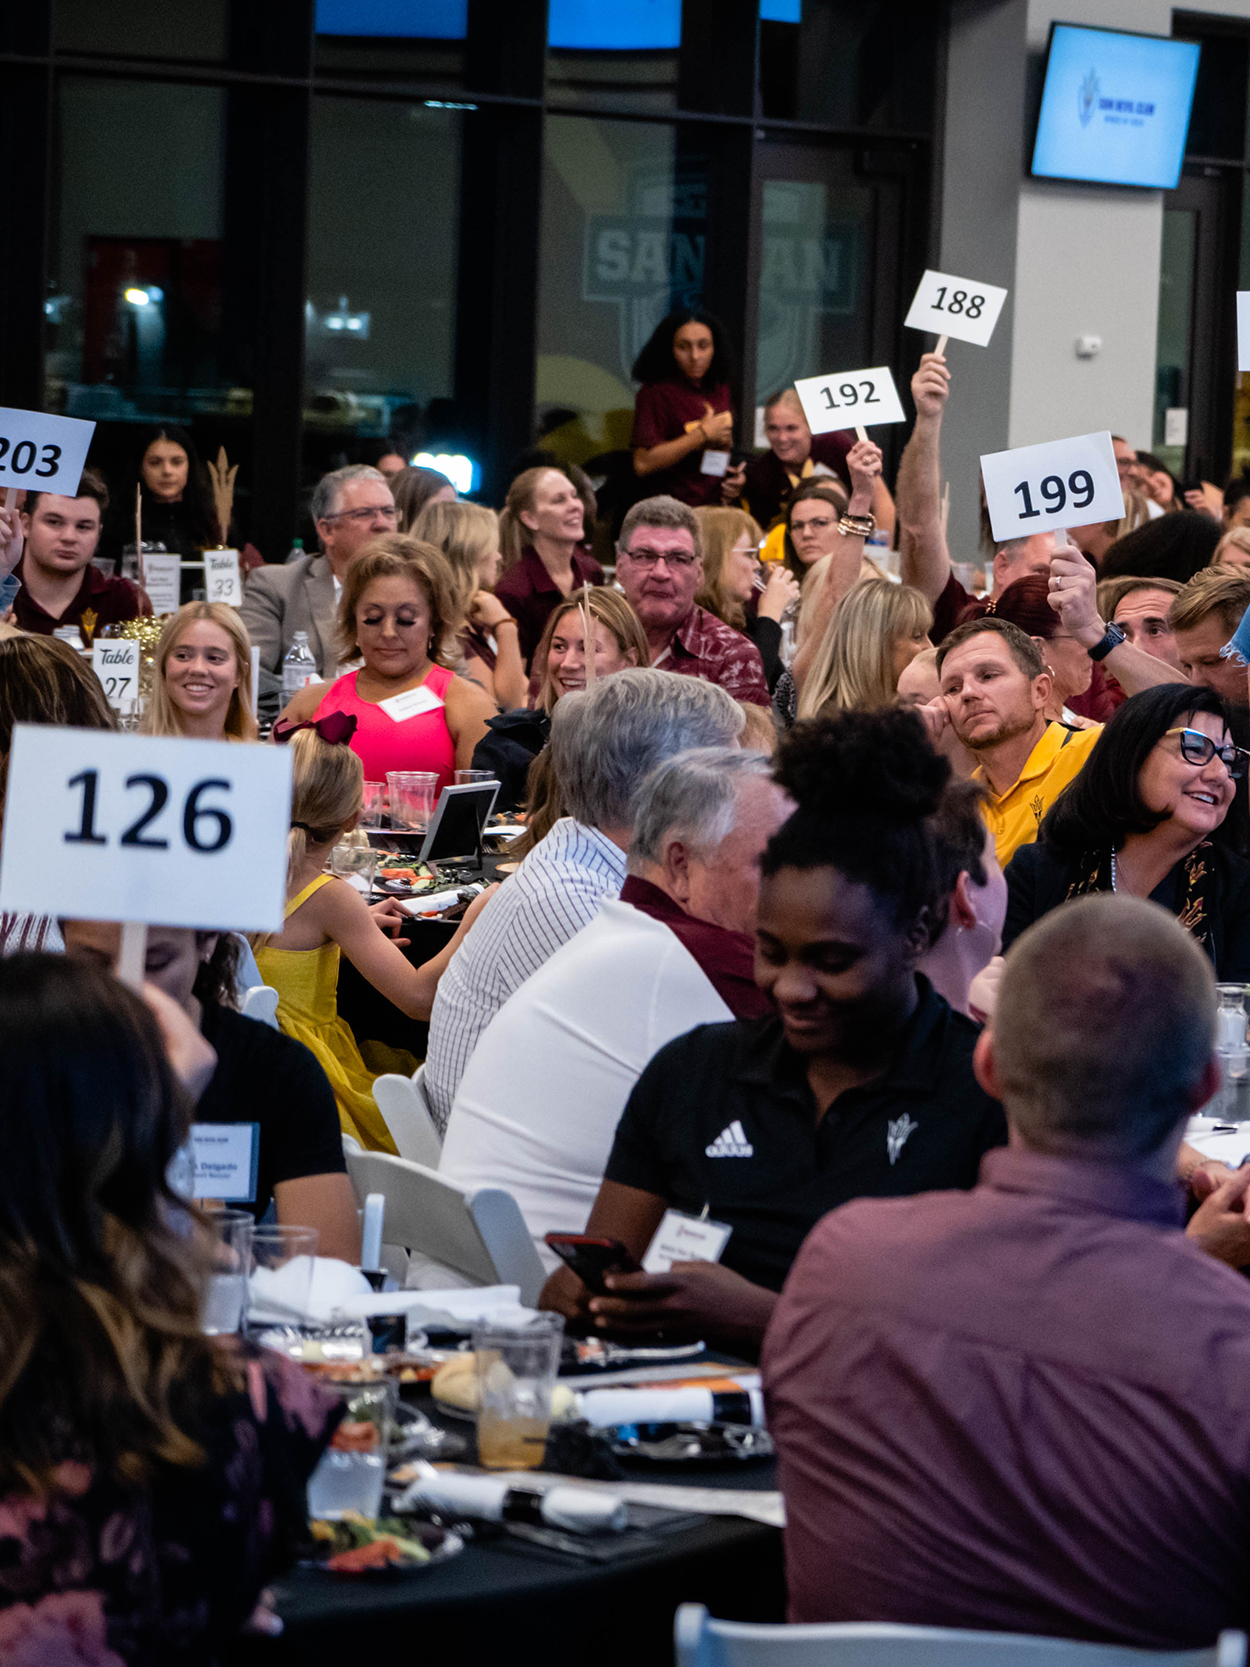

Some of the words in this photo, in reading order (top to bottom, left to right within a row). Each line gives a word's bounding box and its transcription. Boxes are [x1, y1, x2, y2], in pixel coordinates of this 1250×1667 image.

[930, 286, 985, 319] 188
[819, 381, 880, 410] 192
[1013, 470, 1096, 520] 199
[210, 557, 234, 571] Table
[215, 578, 233, 597] 33
[100, 647, 135, 666] Table
[105, 676, 132, 699] 27
[63, 769, 234, 854] 126
[705, 1143, 753, 1158] adidas
